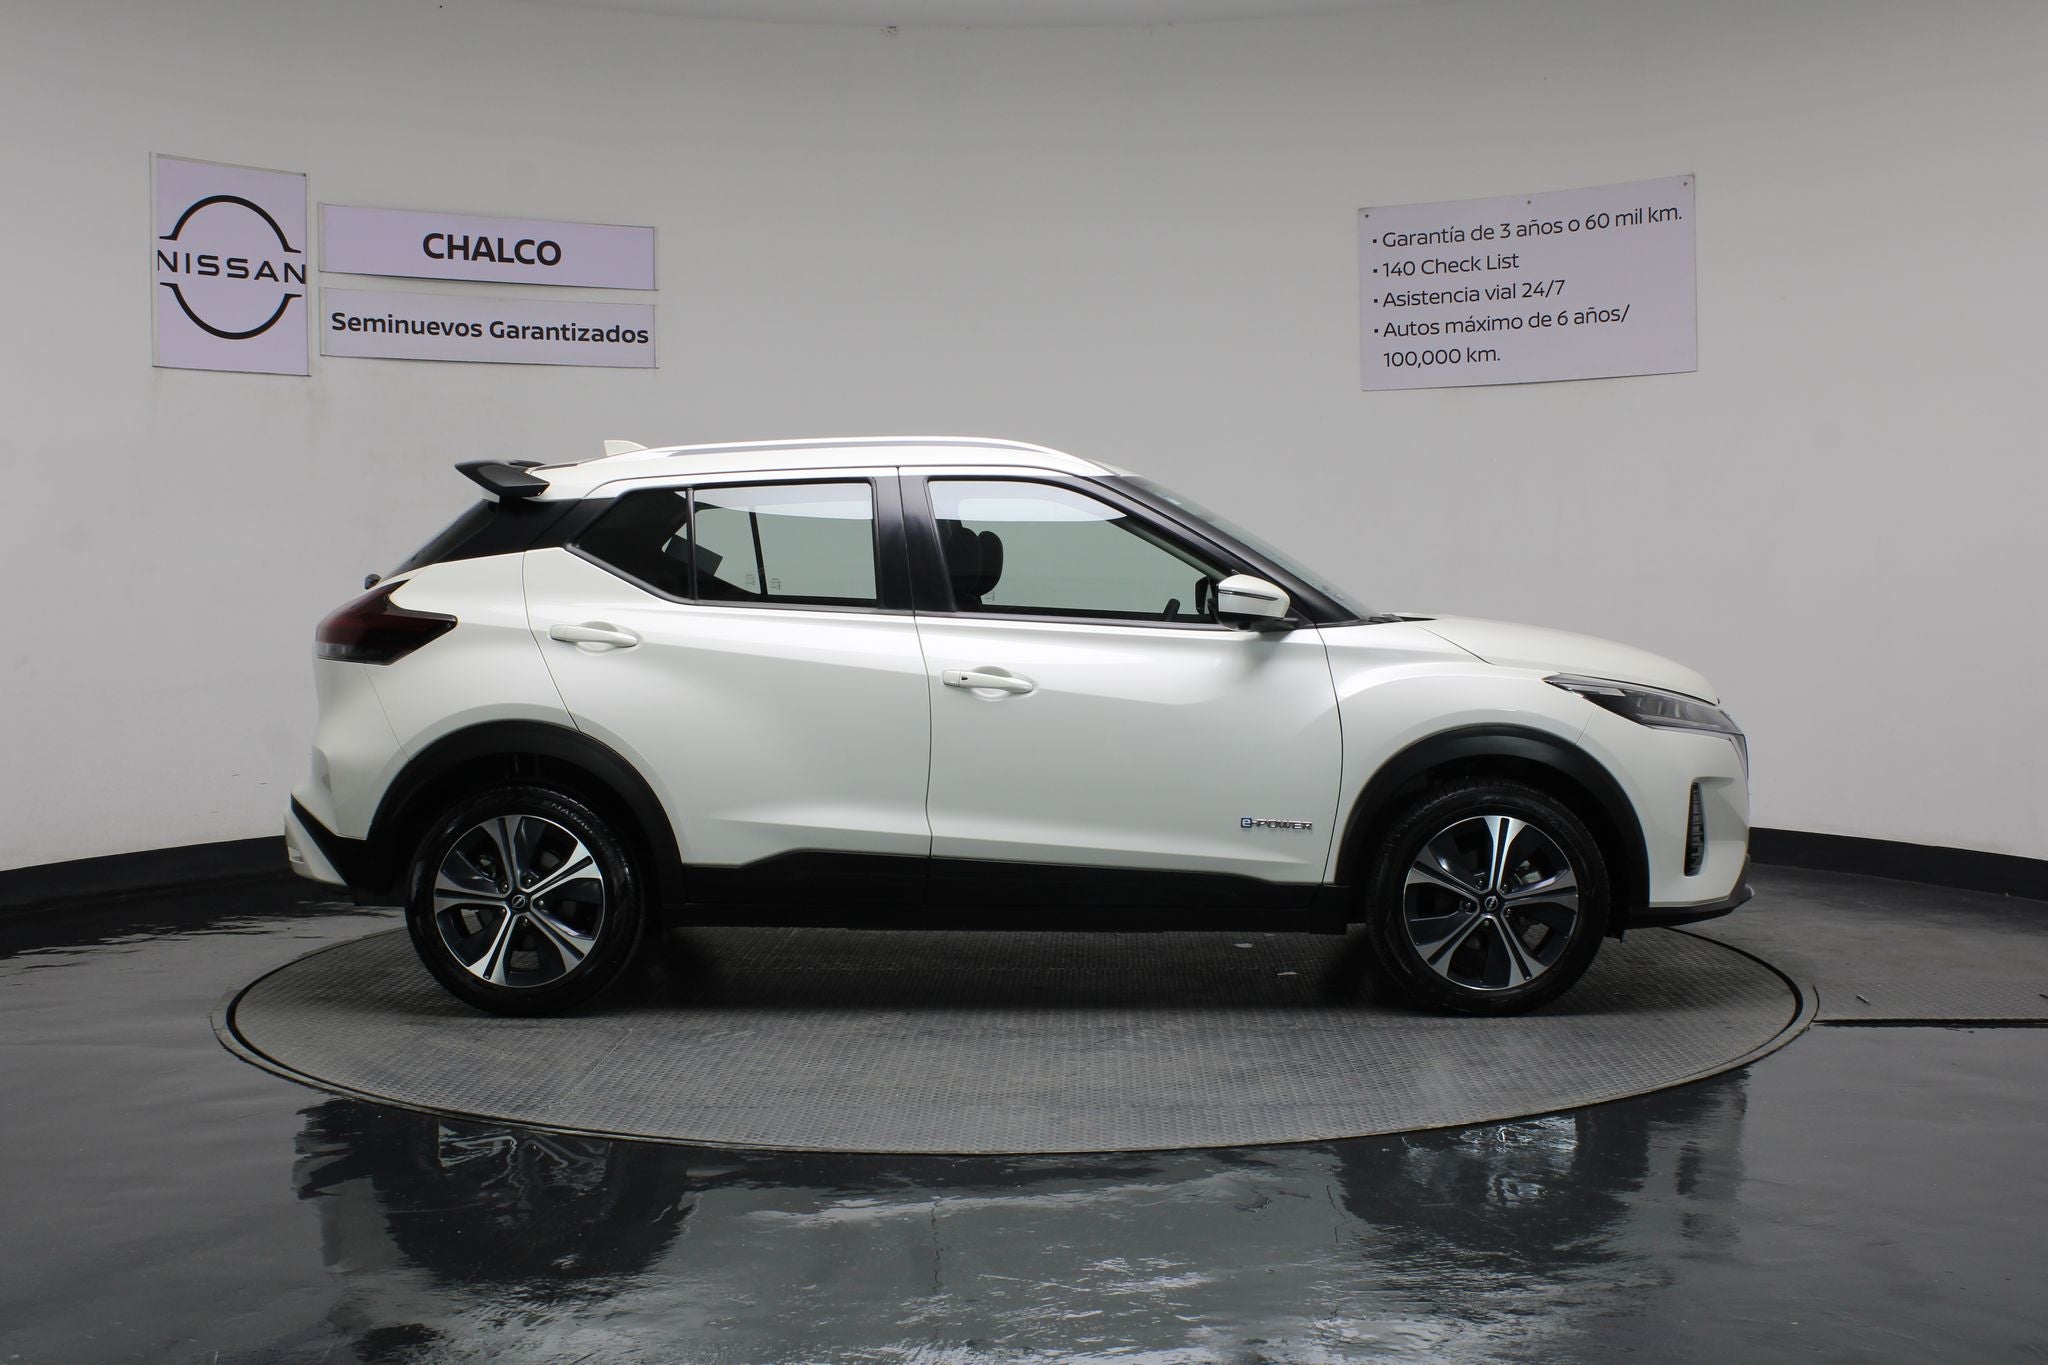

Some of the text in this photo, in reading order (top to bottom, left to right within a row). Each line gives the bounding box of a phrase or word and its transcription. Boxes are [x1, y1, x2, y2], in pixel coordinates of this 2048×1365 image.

[1383, 206, 1683, 248] Garantía de 3 años o 60 mil km.
[422, 232, 562, 267] CHALCO
[1382, 253, 1520, 278] 140 Check List
[157, 249, 307, 285] NISSAN
[1383, 279, 1566, 308] Asistencia vial 24/7
[331, 312, 649, 344] Seminuevos Garantizados
[1383, 303, 1631, 338] Autos máximo de 6 años/
[1383, 346, 1501, 369] 100,000 km.
